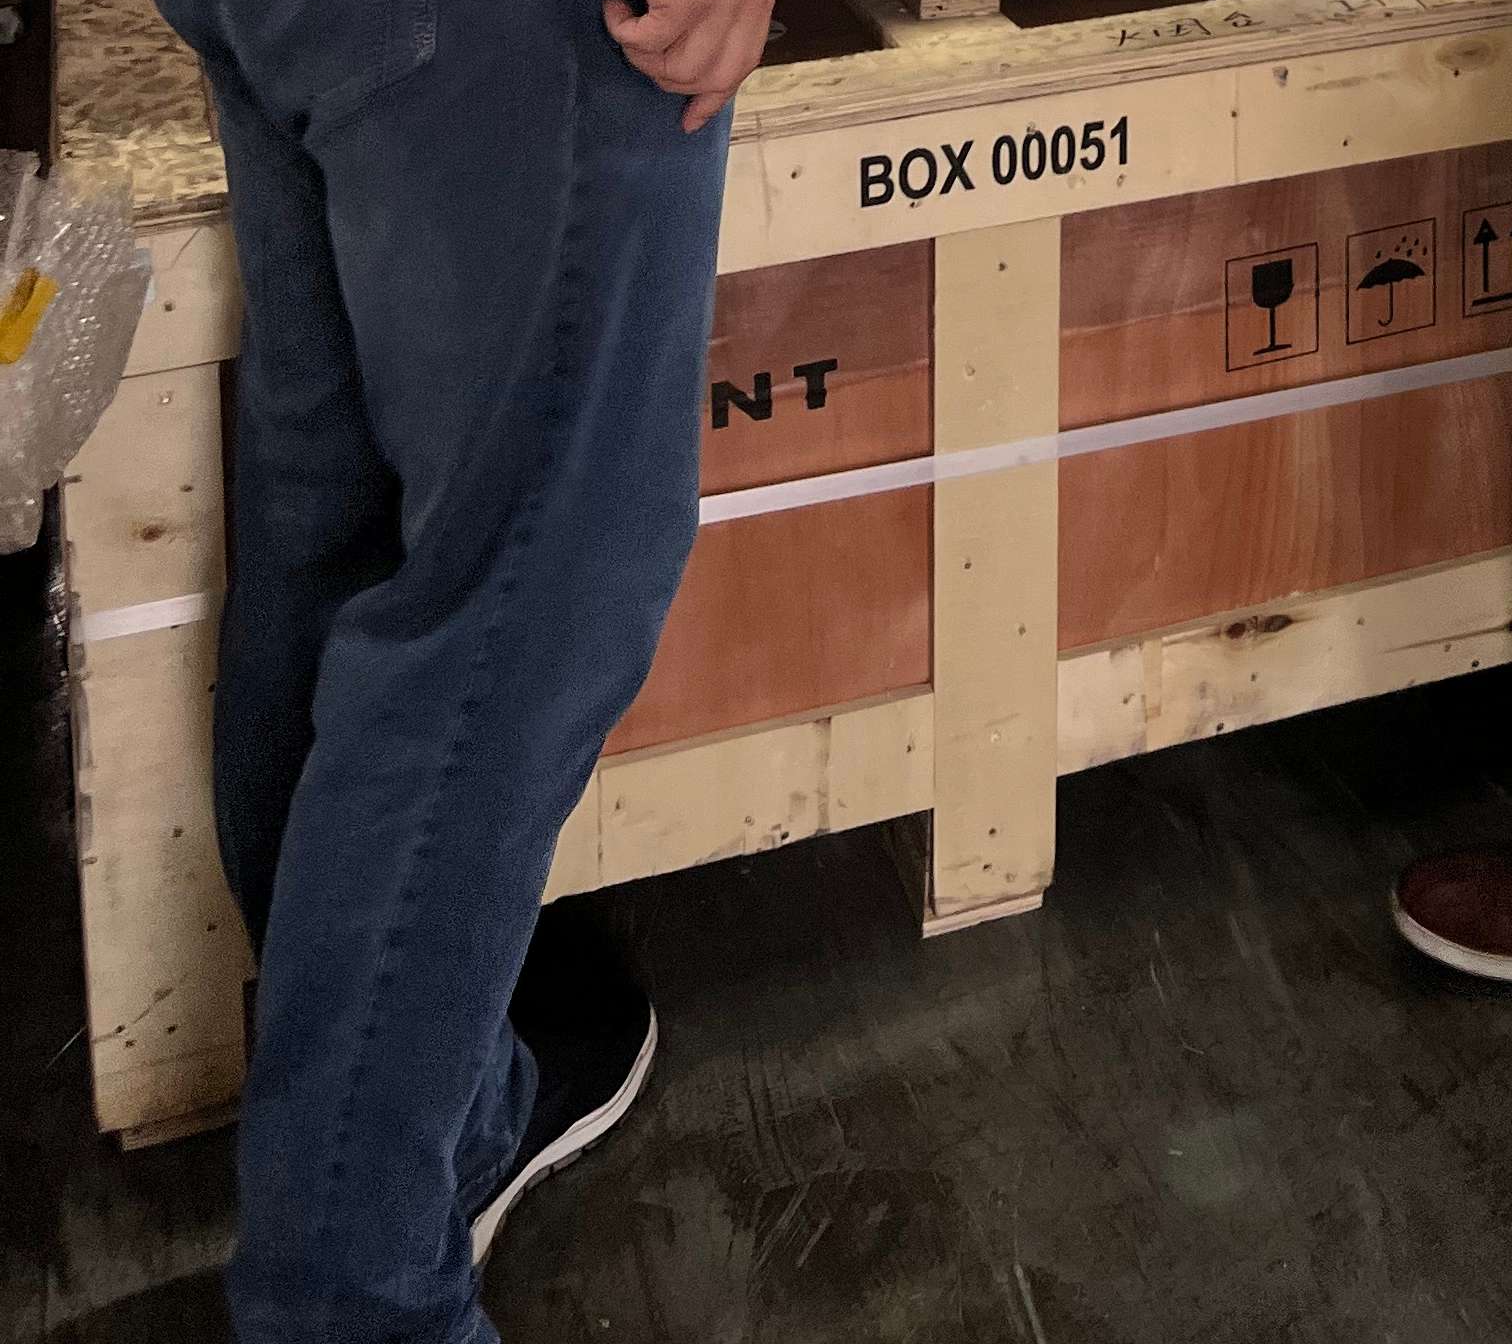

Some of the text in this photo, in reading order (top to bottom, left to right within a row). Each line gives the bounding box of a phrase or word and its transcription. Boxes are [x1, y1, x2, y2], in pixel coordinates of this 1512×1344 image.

[859, 115, 1129, 209] BOX 00051
[710, 357, 839, 431] NT
